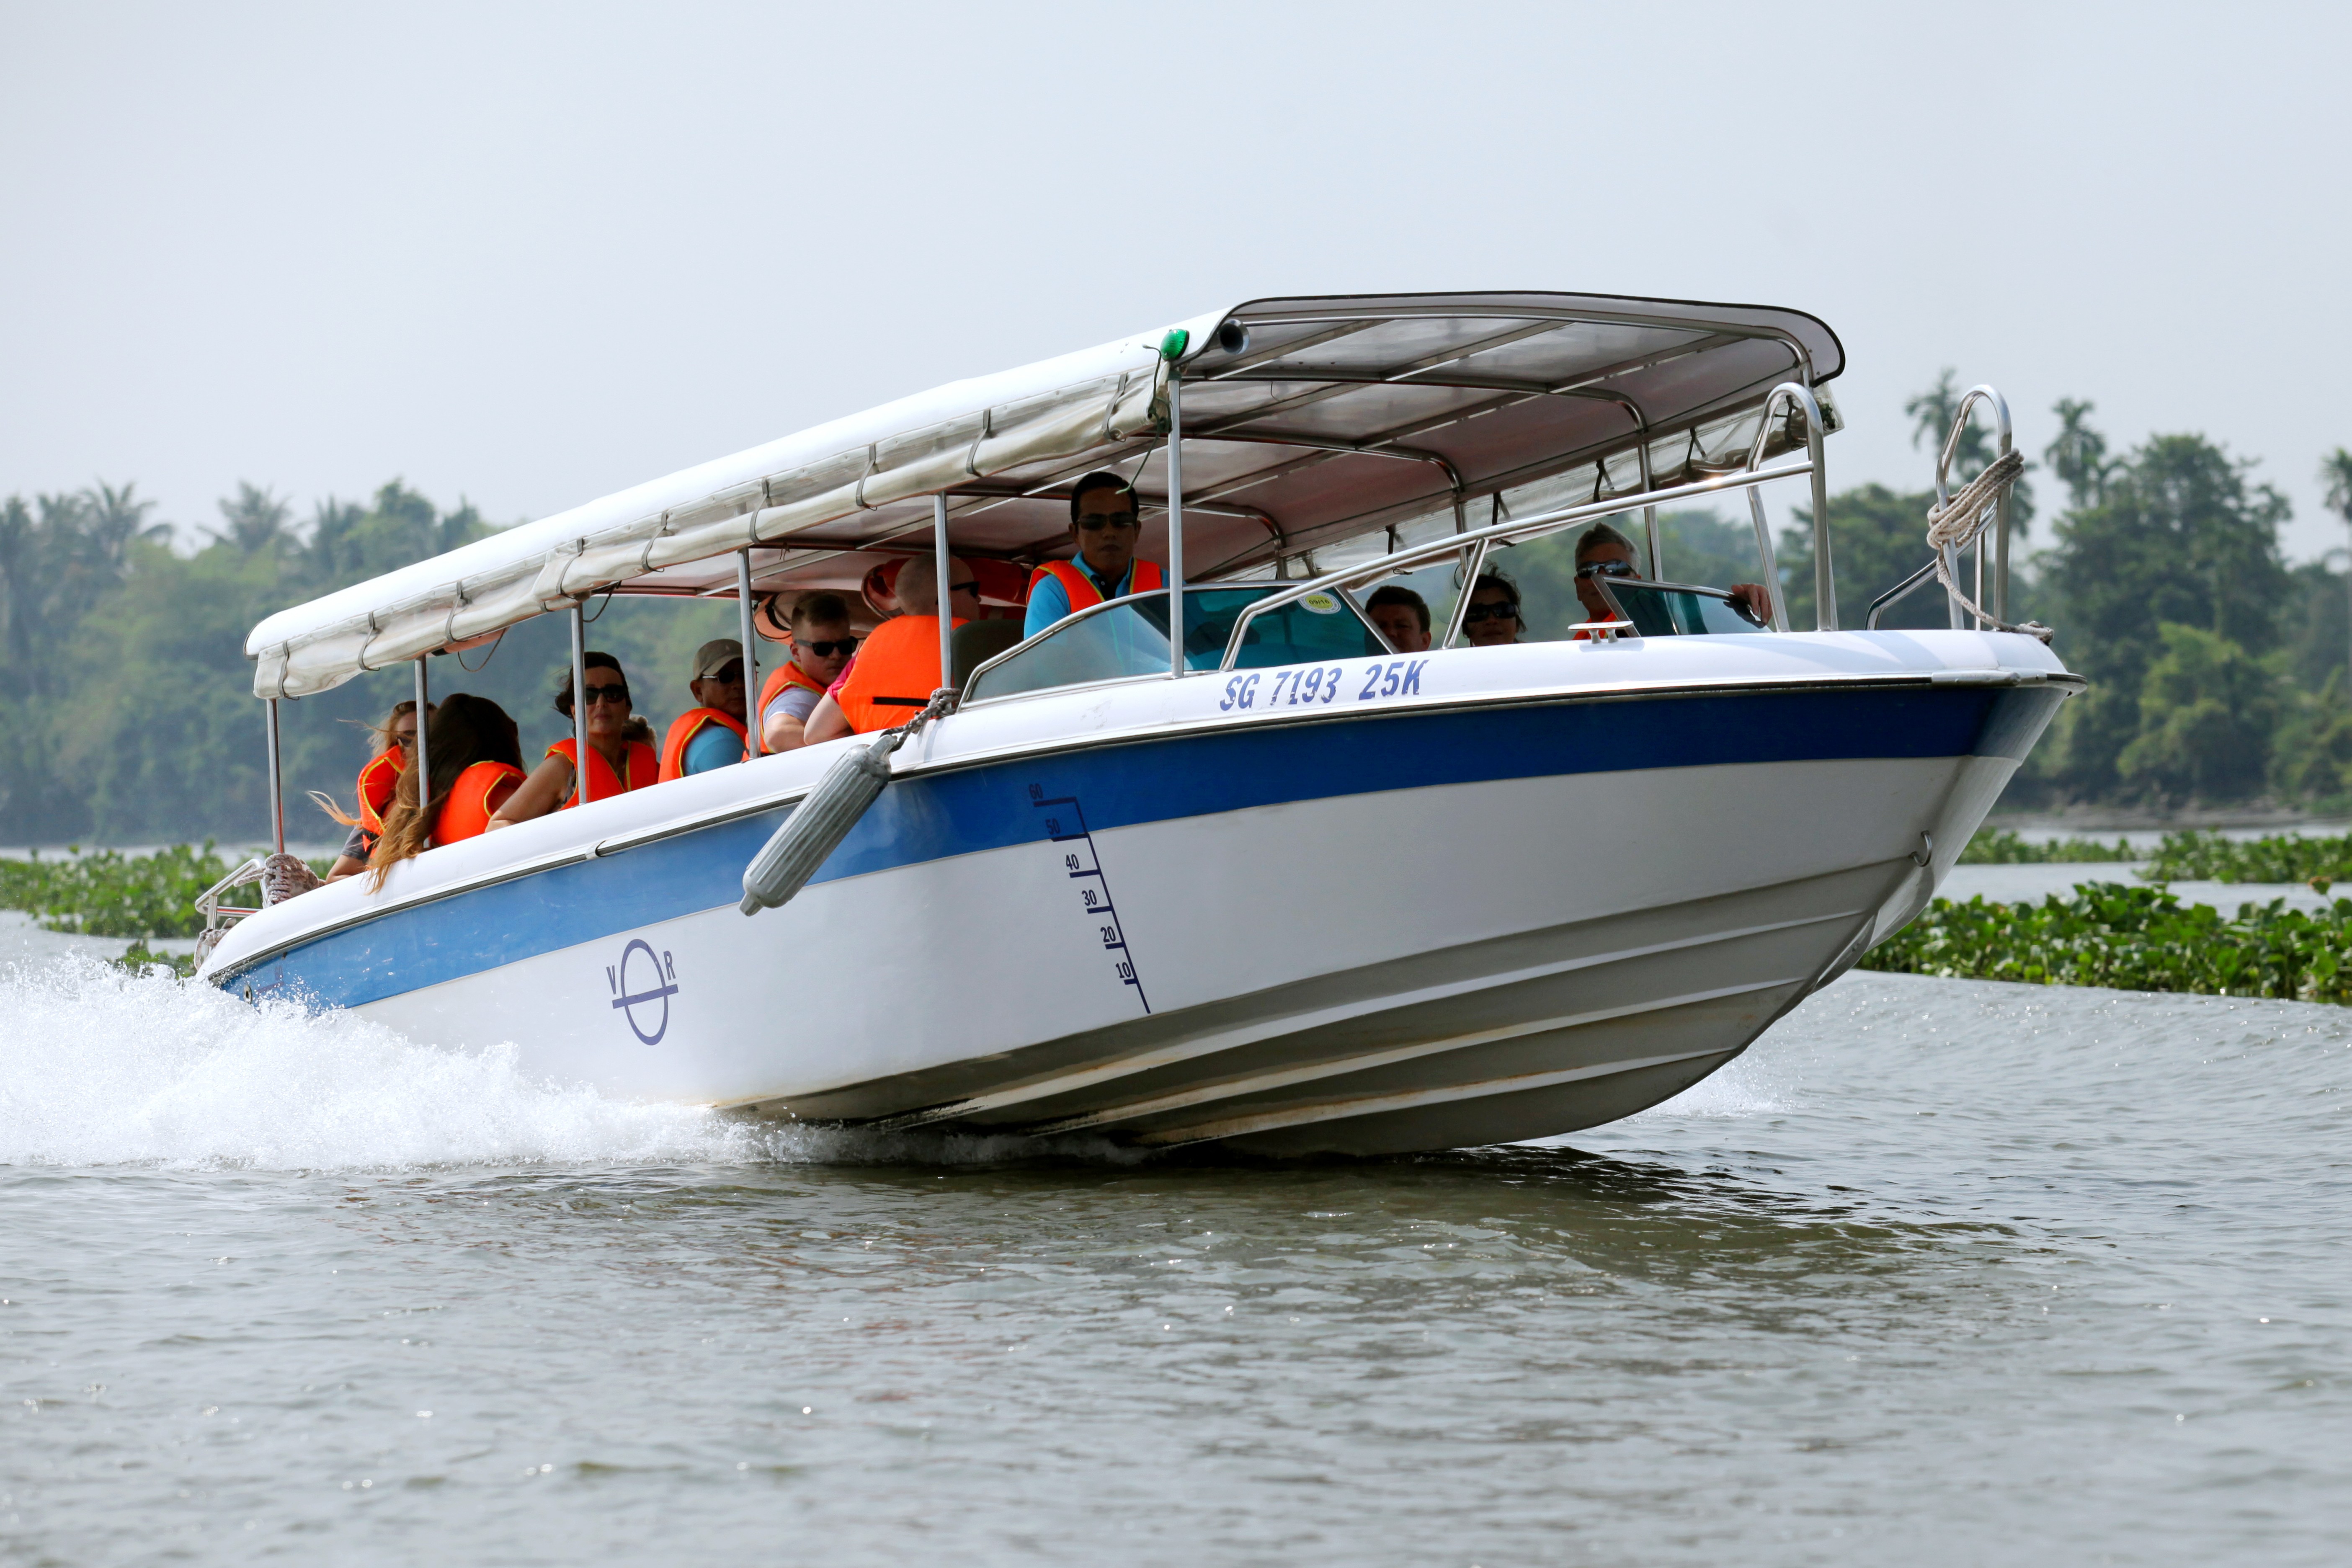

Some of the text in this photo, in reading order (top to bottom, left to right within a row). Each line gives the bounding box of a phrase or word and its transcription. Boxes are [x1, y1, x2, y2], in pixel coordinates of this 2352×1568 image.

[1220, 659, 1430, 711] SG 7193 25K
[1029, 783, 1043, 799] 60
[1045, 818, 1060, 835] 50
[1066, 854, 1079, 870] 40
[1082, 890, 1097, 906] 30
[1101, 926, 1116, 942] 20
[606, 951, 676, 995] V R
[1116, 962, 1131, 978] 10
